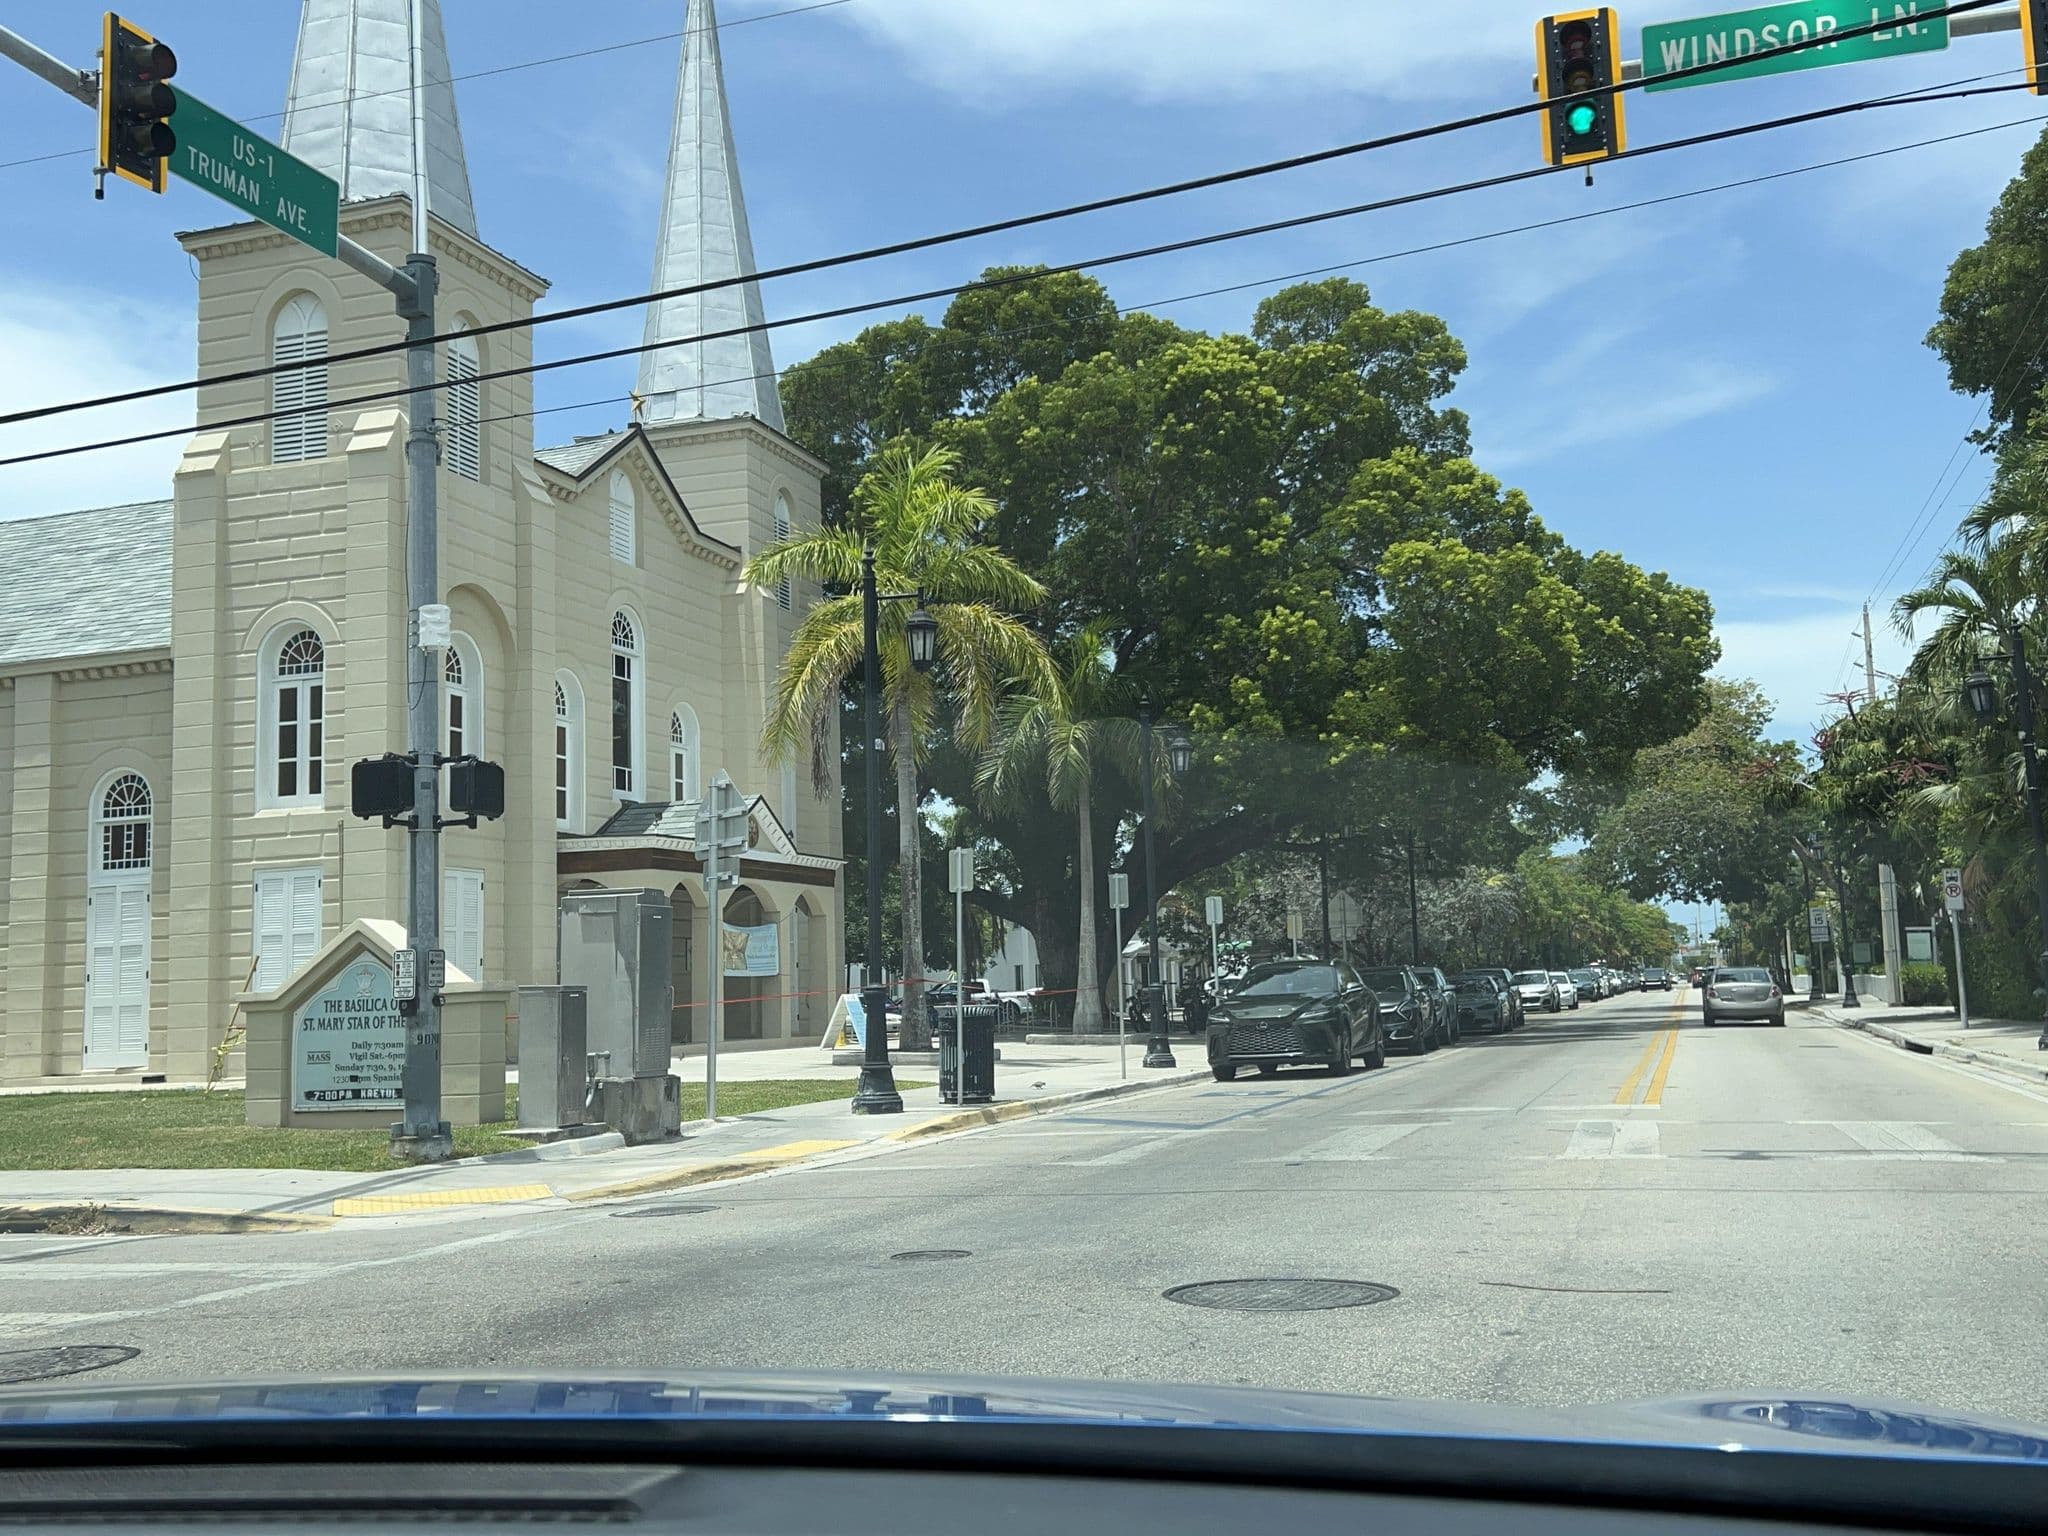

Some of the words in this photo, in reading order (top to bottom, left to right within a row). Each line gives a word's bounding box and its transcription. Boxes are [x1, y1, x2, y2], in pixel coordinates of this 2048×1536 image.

[1660, 15, 1838, 73] WINDSOR
[1872, 1, 1928, 41] LN.
[232, 135, 273, 178] US-1
[187, 145, 260, 206] TRUMAN
[277, 197, 311, 235] AVE.
[324, 1000, 343, 1014] THE
[344, 998, 388, 1013] BASILICA
[390, 998, 401, 1012] O
[303, 1018, 316, 1032] ST.
[317, 1017, 345, 1031] MARY
[347, 1016, 370, 1030] STAR
[372, 1015, 386, 1029] OF
[387, 1015, 406, 1028] THE
[351, 1041, 373, 1051] Daily
[373, 1041, 404, 1051] 7:30am
[307, 1053, 331, 1062] MASS
[349, 1052, 369, 1062] Vigil
[334, 1063, 365, 1073] Sunday
[373, 1073, 402, 1083] Spanis
